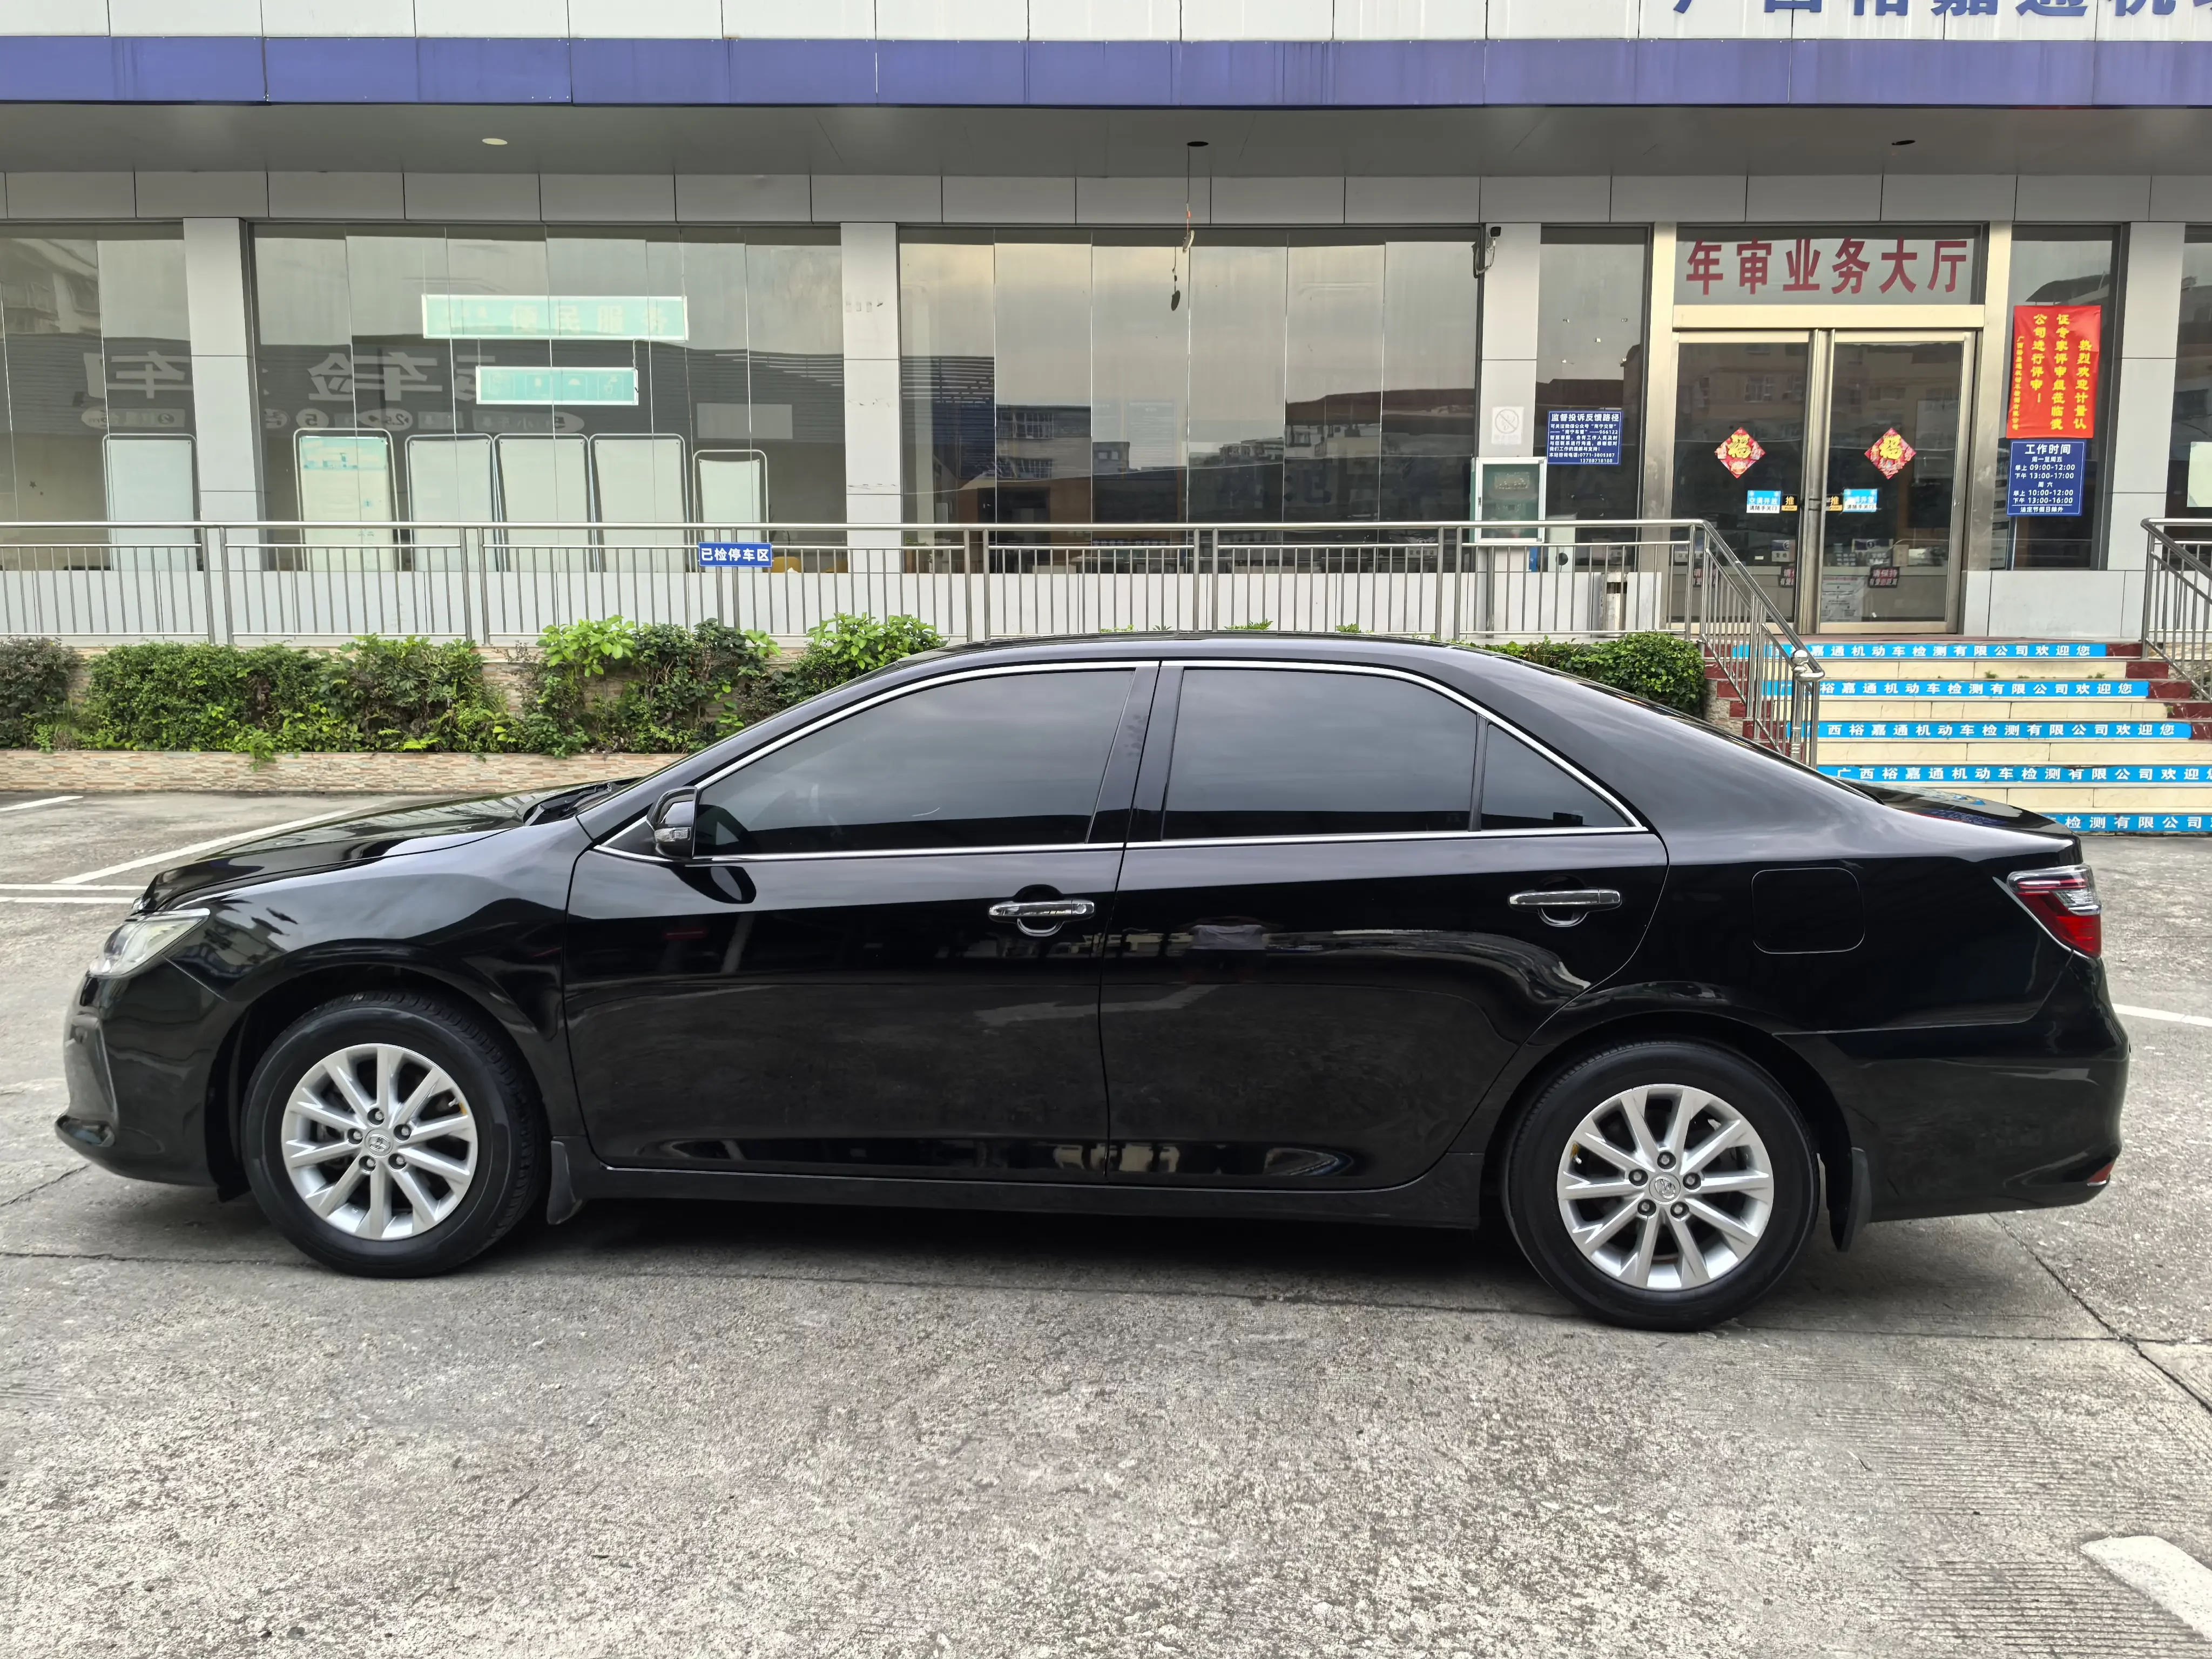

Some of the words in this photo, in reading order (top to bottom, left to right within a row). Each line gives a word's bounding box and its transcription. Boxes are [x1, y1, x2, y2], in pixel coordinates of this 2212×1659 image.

[1686, 237, 1967, 295] 年审业务大厅
[2050, 313, 2071, 430] 证专家评审组莅临我
[2073, 339, 2093, 430] 热烈欢迎计量认
[1551, 413, 1619, 422] 监督投诉反馈路径
[2025, 443, 2071, 455] 工作时间
[1785, 496, 1795, 505] 推
[1830, 496, 1839, 505] 推
[701, 547, 770, 562] 已检停车区
[1771, 644, 2090, 657] 嘉通机动车检测有限公司欢迎您
[1781, 682, 2133, 696] 裕嘉通机动车检测有限公司欢迎您
[1807, 724, 2175, 737] 西裕嘉通机动车检测有限公司欢迎您
[2047, 814, 2212, 829] 检测有限公司
